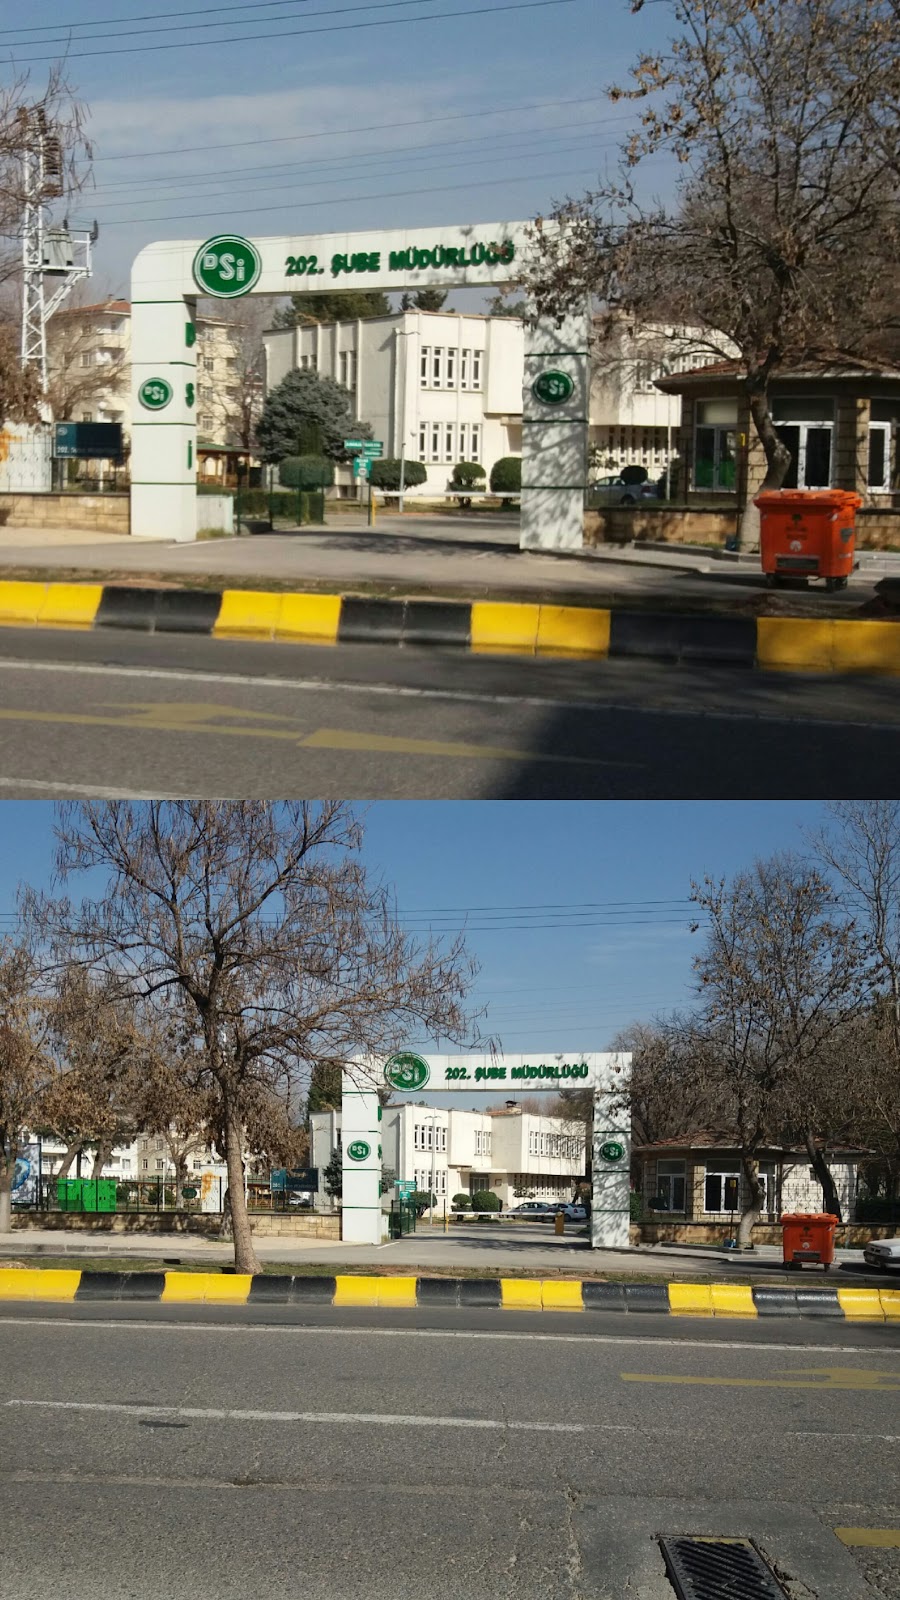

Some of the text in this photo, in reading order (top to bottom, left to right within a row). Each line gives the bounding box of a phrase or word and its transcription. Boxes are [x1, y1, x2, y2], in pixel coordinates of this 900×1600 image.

[284, 240, 514, 279] 202. ŞUBE MÜDÜRLÜĞÜ
[444, 1063, 589, 1083] 202. ŞUBE MÜDÜRLÜĞÜ
